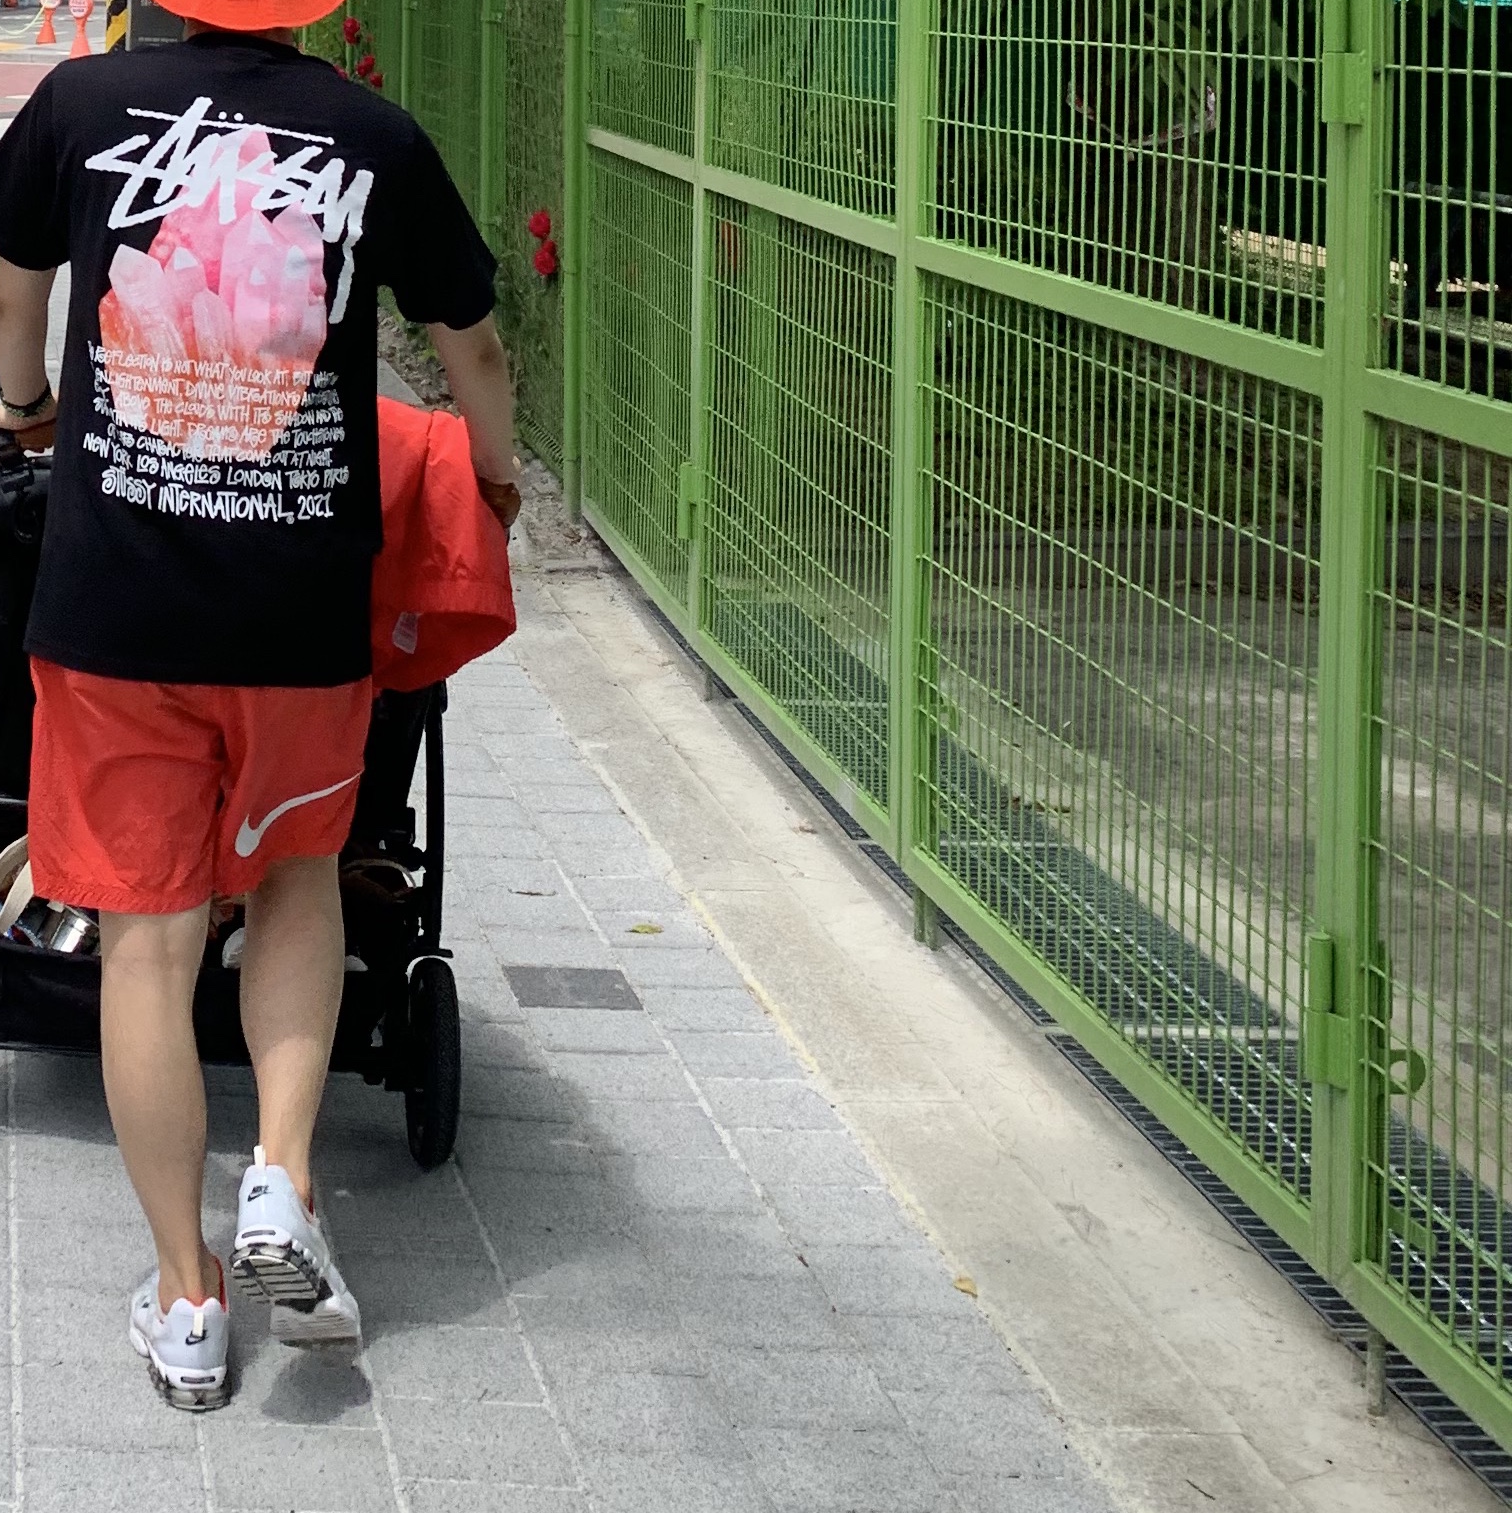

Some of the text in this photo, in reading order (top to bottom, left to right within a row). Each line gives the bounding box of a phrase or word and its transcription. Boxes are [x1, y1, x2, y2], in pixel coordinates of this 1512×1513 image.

[174, 359, 196, 375] NOT
[194, 360, 230, 381] WHAT
[229, 365, 247, 384] YOU
[247, 367, 272, 385] LOOK
[292, 370, 313, 386] BUT
[174, 401, 215, 419] CLOUDS
[217, 404, 250, 422] WITH
[83, 433, 110, 459] NEW
[136, 453, 159, 475] LOS
[226, 465, 283, 491] LONDON
[284, 468, 320, 490] TOKYO
[272, 449, 295, 467] OUT
[297, 491, 334, 520] 2021
